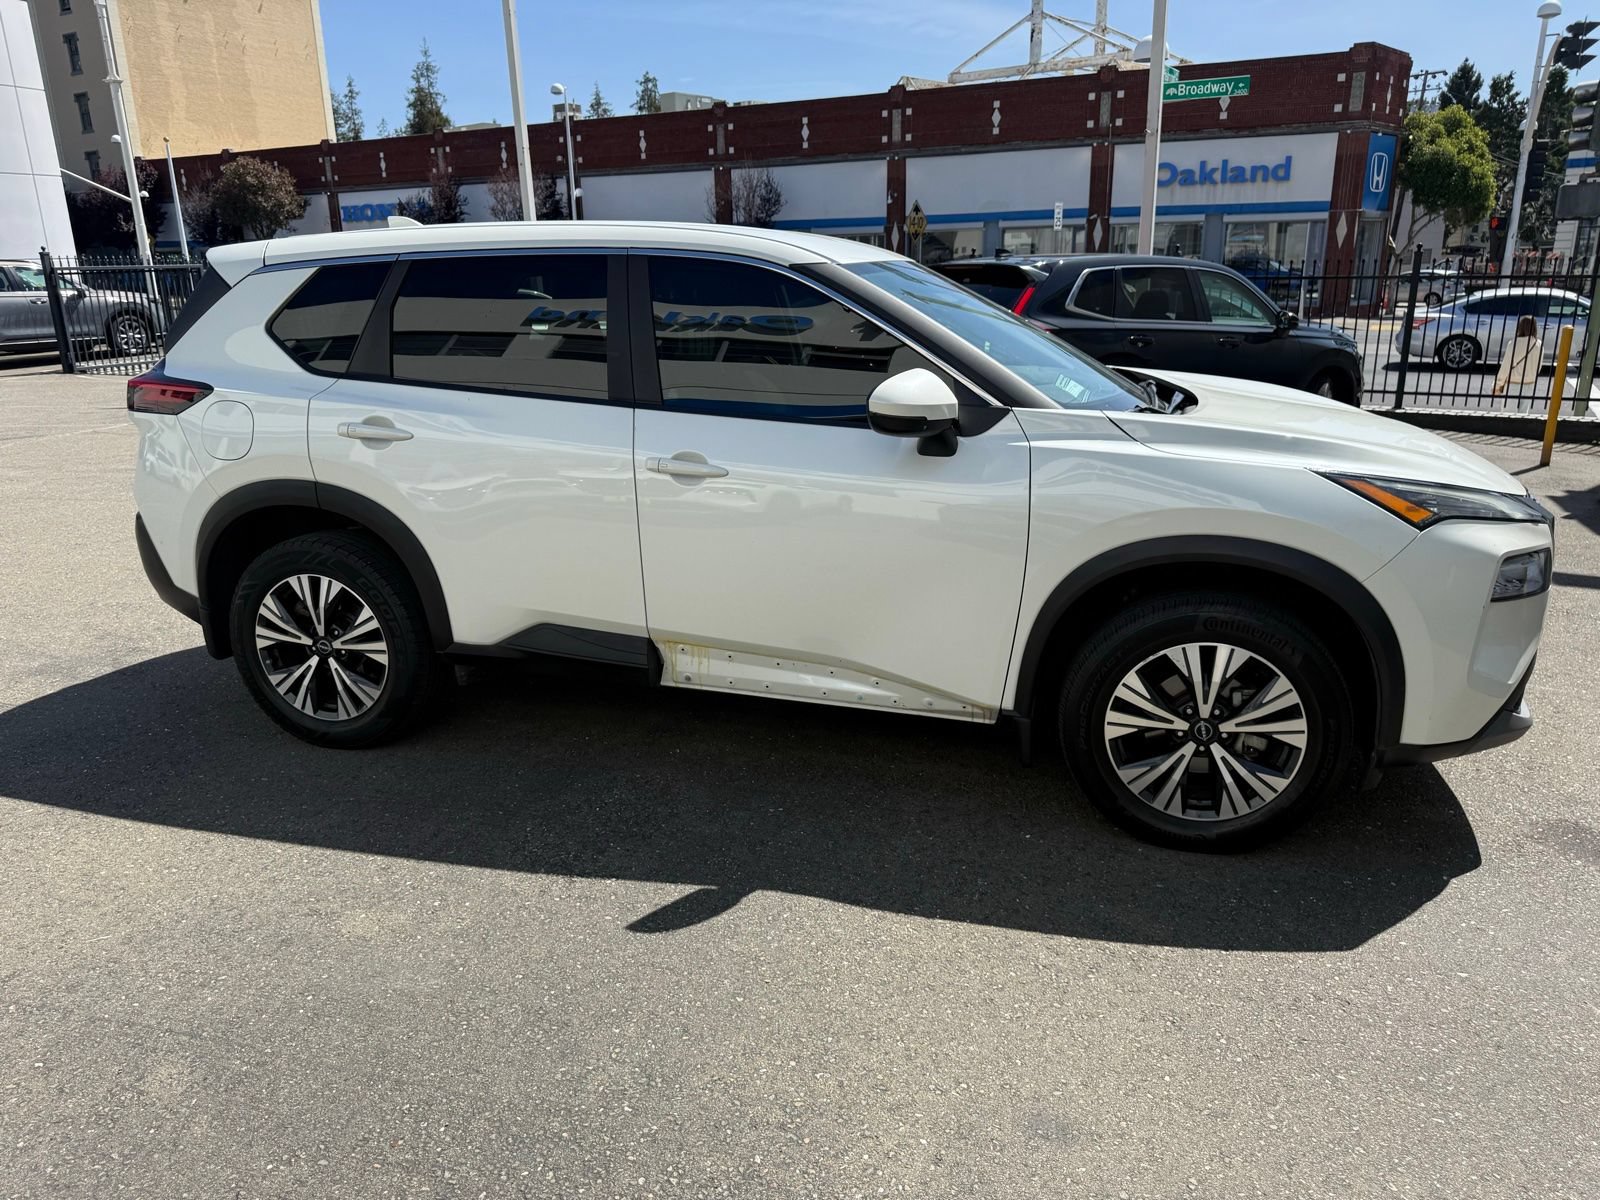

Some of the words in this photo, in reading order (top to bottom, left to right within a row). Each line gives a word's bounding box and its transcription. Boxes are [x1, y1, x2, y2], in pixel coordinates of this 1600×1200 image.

[1178, 82, 1234, 96] Broadway
[1157, 155, 1292, 188] Oakland
[1202, 616, 1290, 651] Continental
